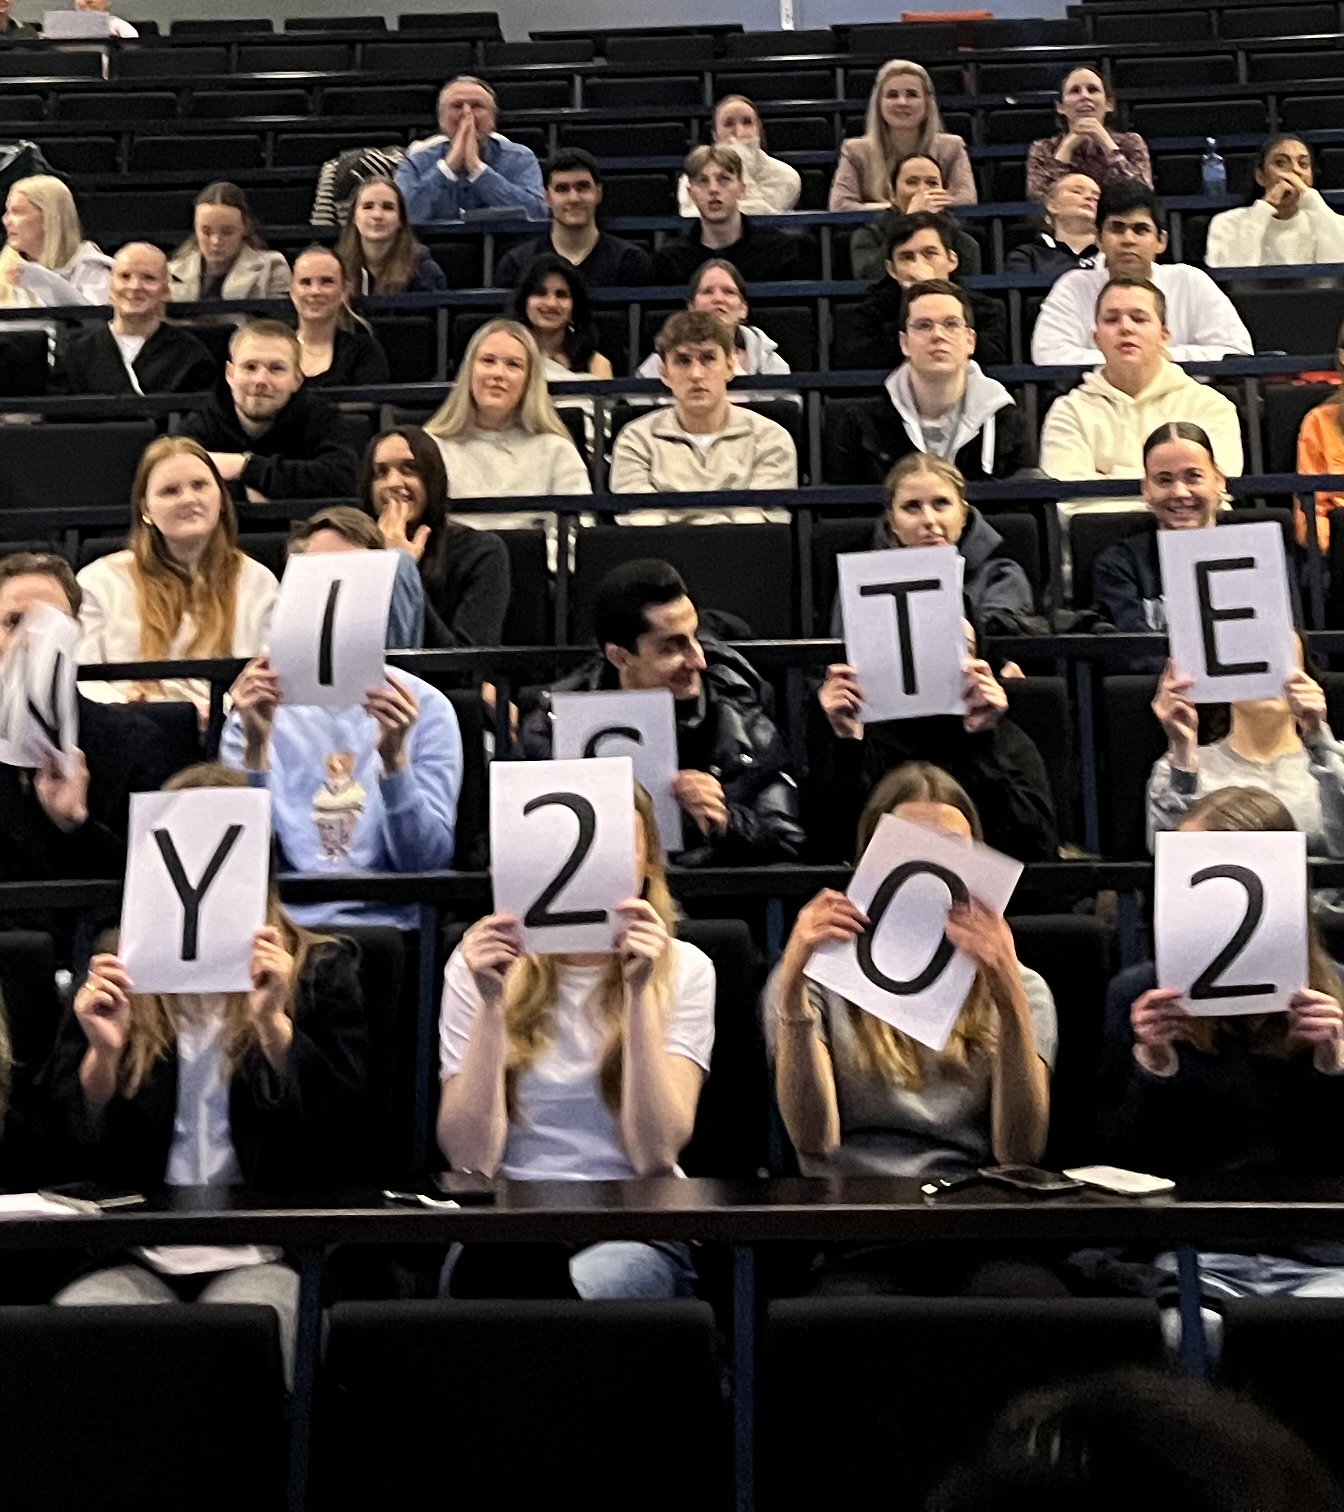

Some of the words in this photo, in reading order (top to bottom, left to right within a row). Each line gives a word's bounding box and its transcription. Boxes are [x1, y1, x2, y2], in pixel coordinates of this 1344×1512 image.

[859, 579, 941, 695] T
[1194, 556, 1269, 678] E
[154, 823, 245, 962] Y
[522, 791, 609, 928] 2
[1189, 863, 1279, 1000] 2
